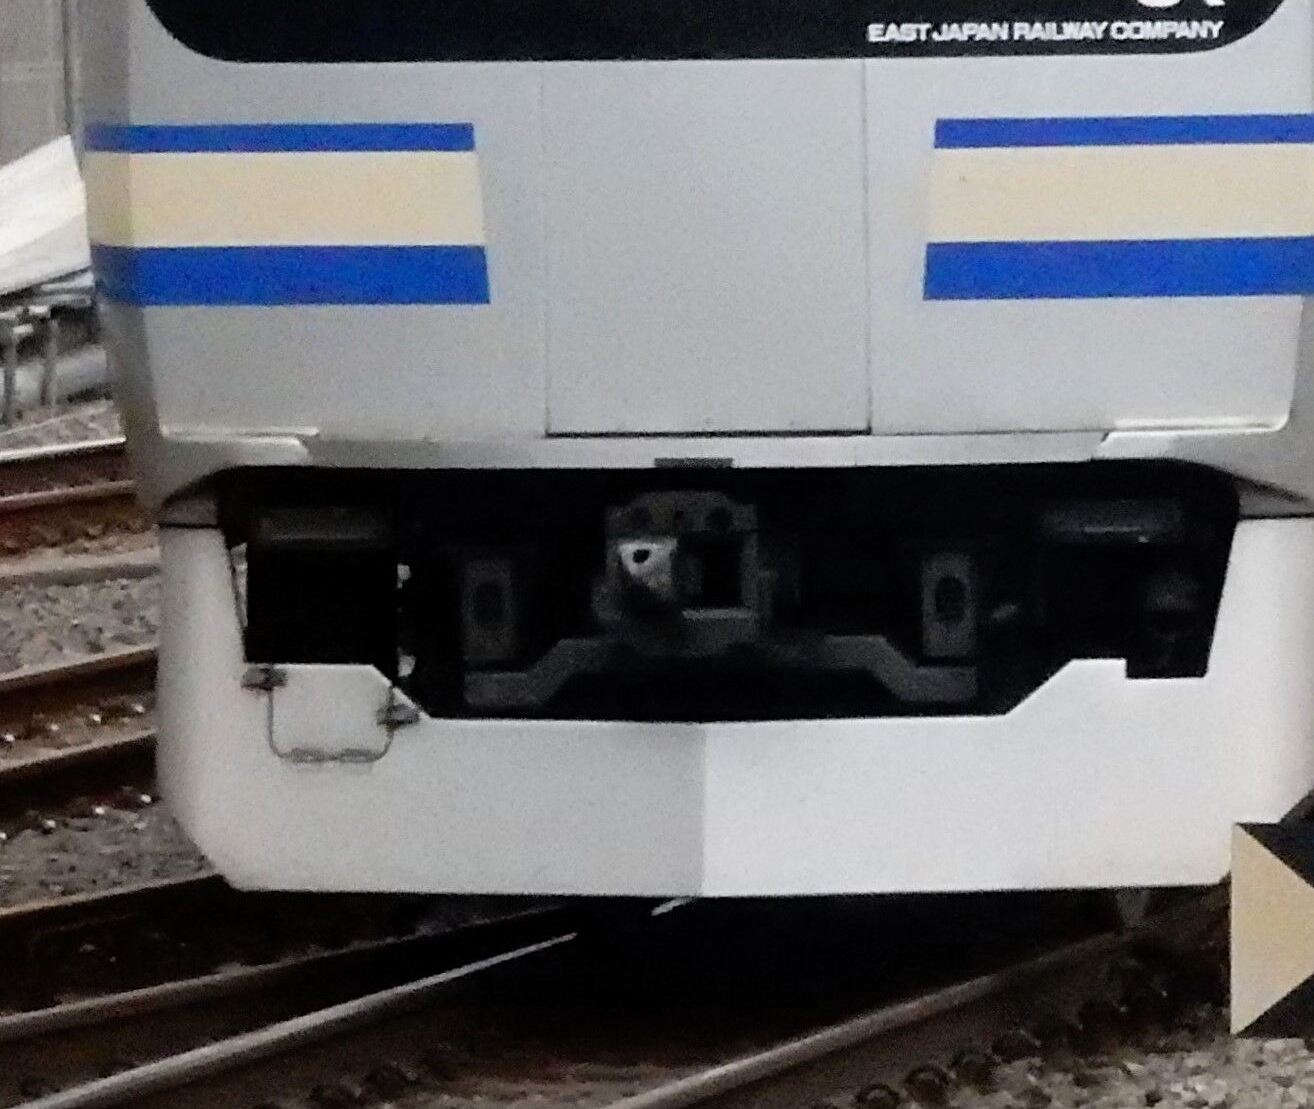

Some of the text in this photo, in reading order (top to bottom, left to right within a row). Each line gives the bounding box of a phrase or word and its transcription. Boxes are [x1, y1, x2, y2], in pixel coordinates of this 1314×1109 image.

[867, 20, 1225, 43] EAST JAPAN RAILWAY COMPANY
